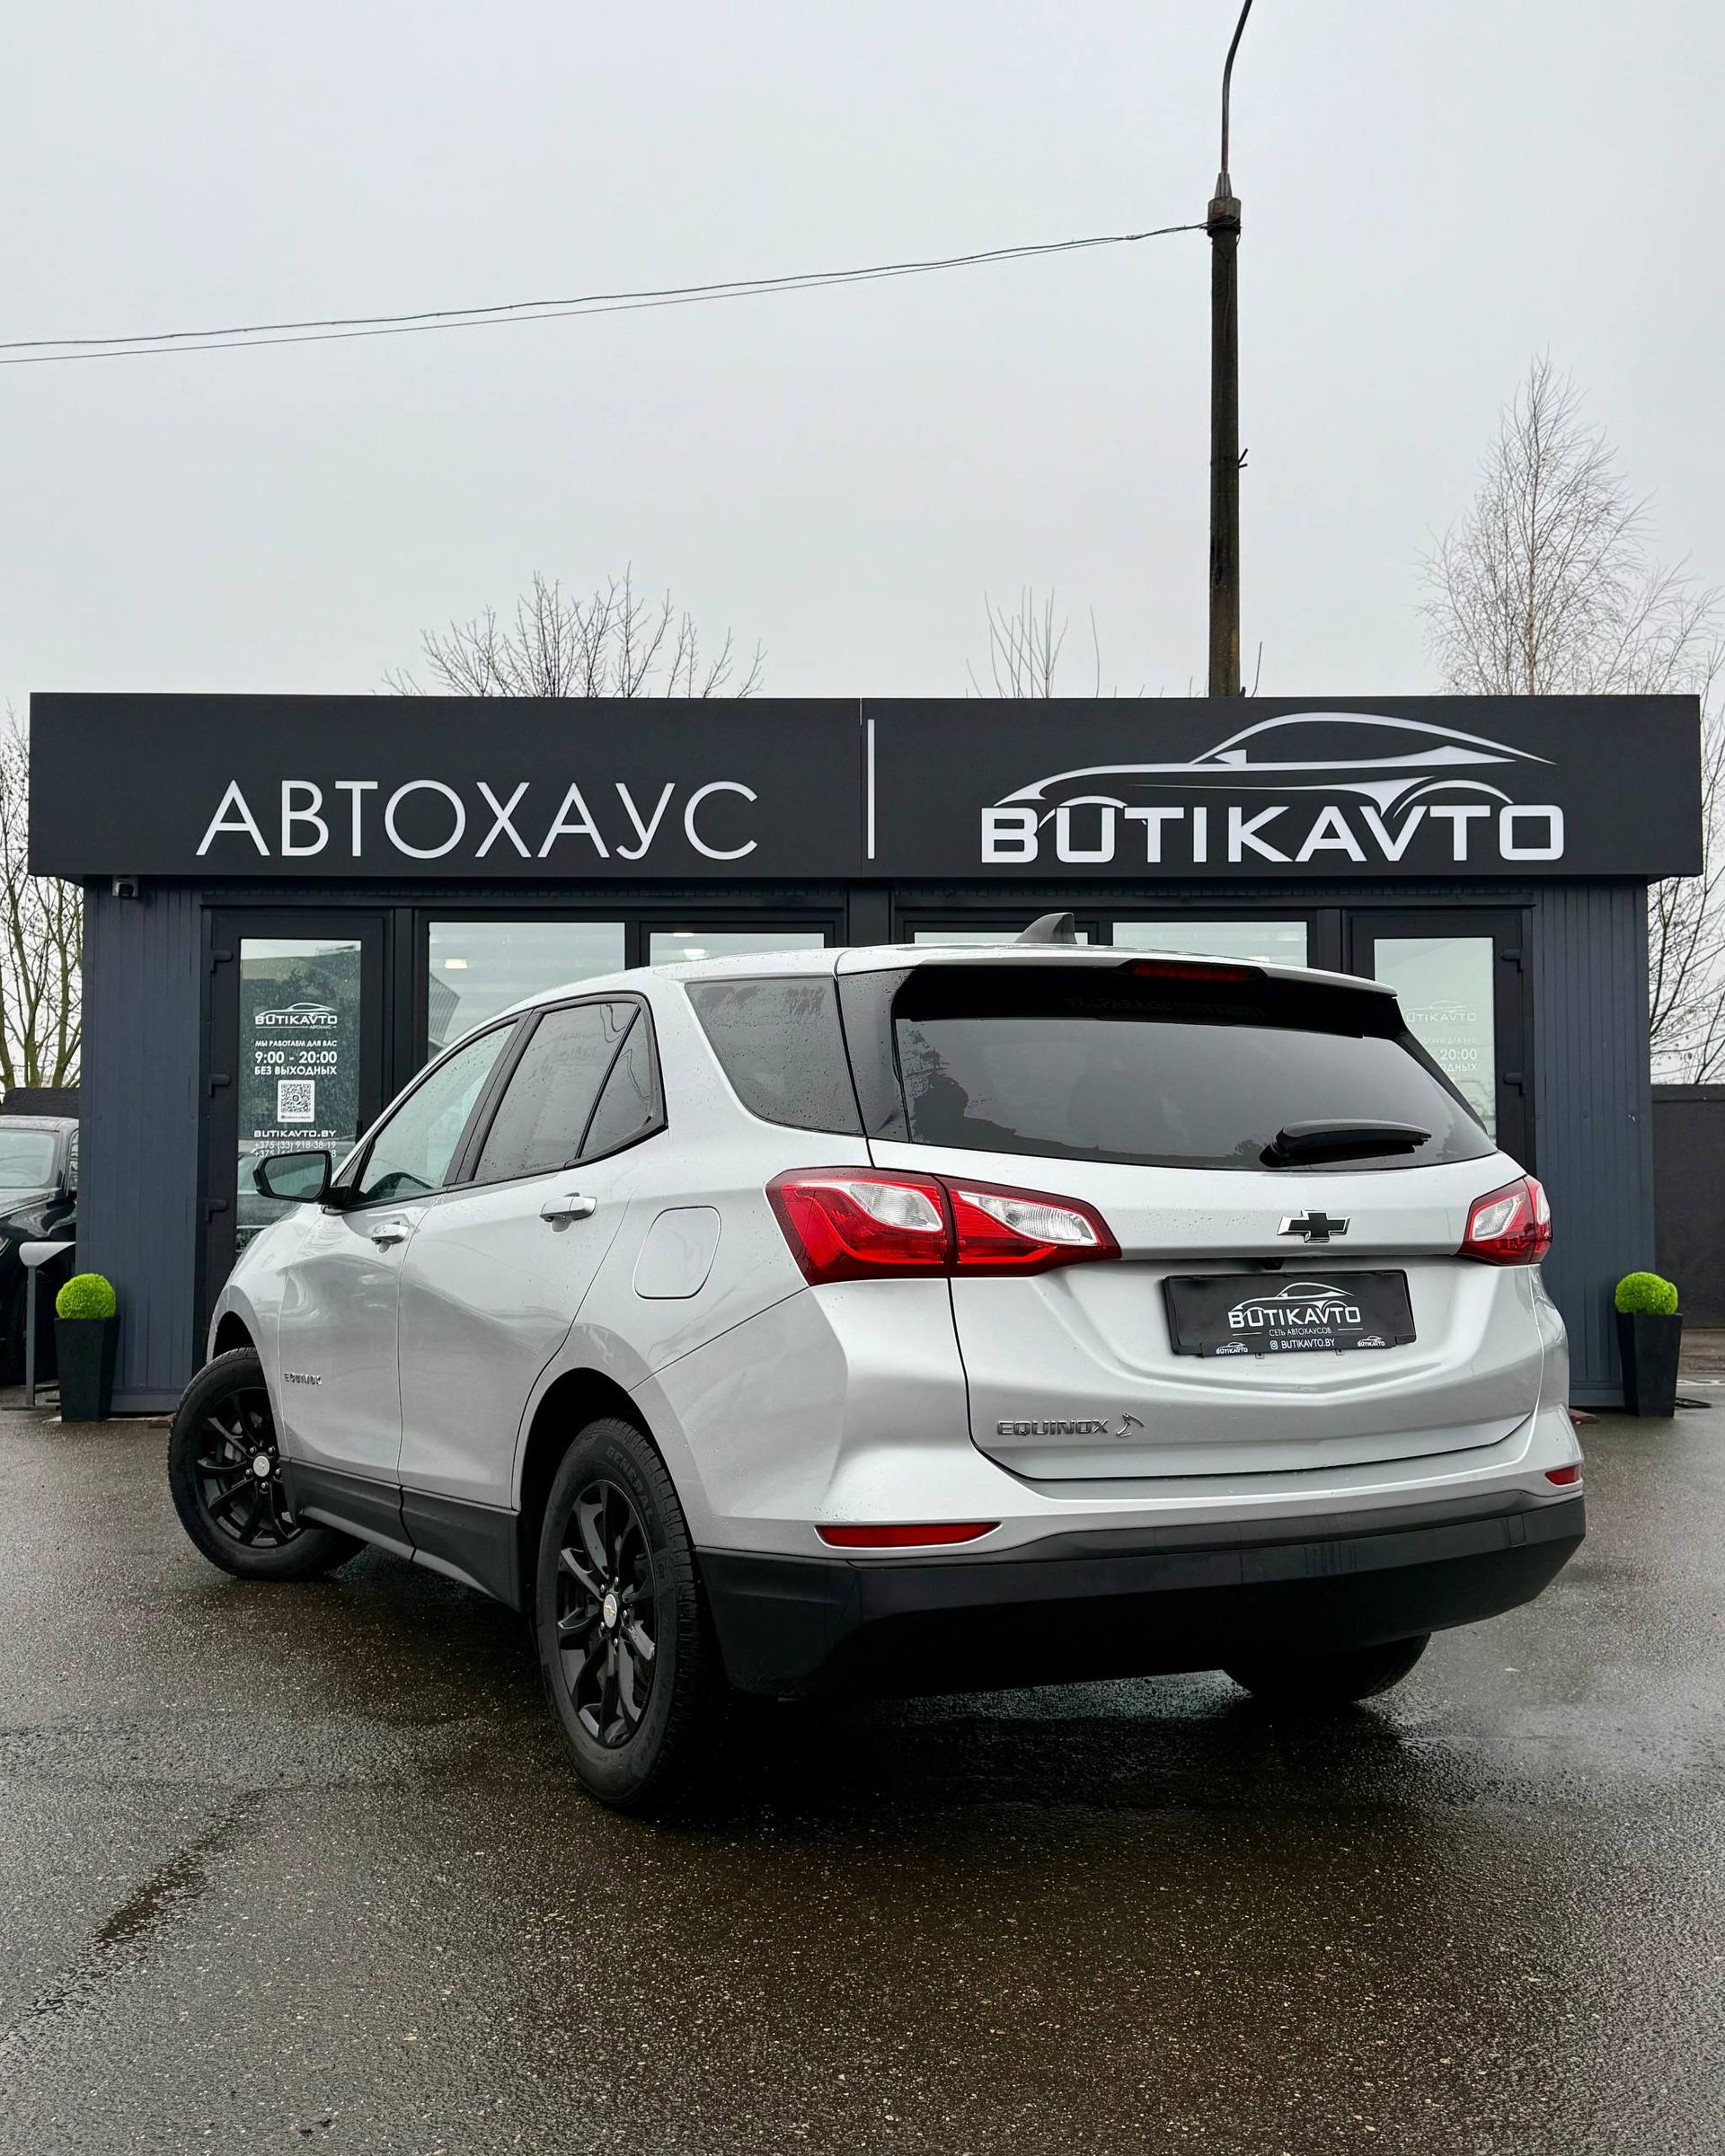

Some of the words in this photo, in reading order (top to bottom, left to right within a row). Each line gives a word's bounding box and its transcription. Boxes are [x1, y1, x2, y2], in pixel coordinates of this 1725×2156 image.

[195, 779, 759, 862] АВТОХАУС
[980, 803, 1565, 864] BUTIKAVTO
[254, 1014, 338, 1025] BUTIKAVTO
[1405, 1012, 1477, 1022] UTIKAVTO
[254, 1039, 268, 1047] МЫ
[269, 1039, 305, 1047] РАБОТАЕМ
[305, 1039, 322, 1048] ДЛЯ
[323, 1039, 338, 1047] ВАС
[254, 1050, 285, 1064] 9:00
[298, 1050, 338, 1064] 20:00
[1439, 1047, 1478, 1061] 20:00
[254, 1065, 272, 1075] БЕЗ
[274, 1065, 337, 1076] ВЫХОДНЫХ
[253, 1129, 337, 1138] BUTIKAVTO.BY
[254, 1140, 275, 1150] +375
[277, 1140, 293, 1151] (33)
[295, 1140, 337, 1150] 918-38-19
[1227, 1305, 1361, 1329] BUTIKAVTO
[1269, 1328, 1286, 1338] СЕТЬ
[1287, 1326, 1331, 1337] АВТОХАУСОВ
[1281, 1337, 1335, 1350] BUTIKAVTO.BY
[996, 1418, 1109, 1436] EQUINOX
[606, 1445, 654, 1524] GENERAL
